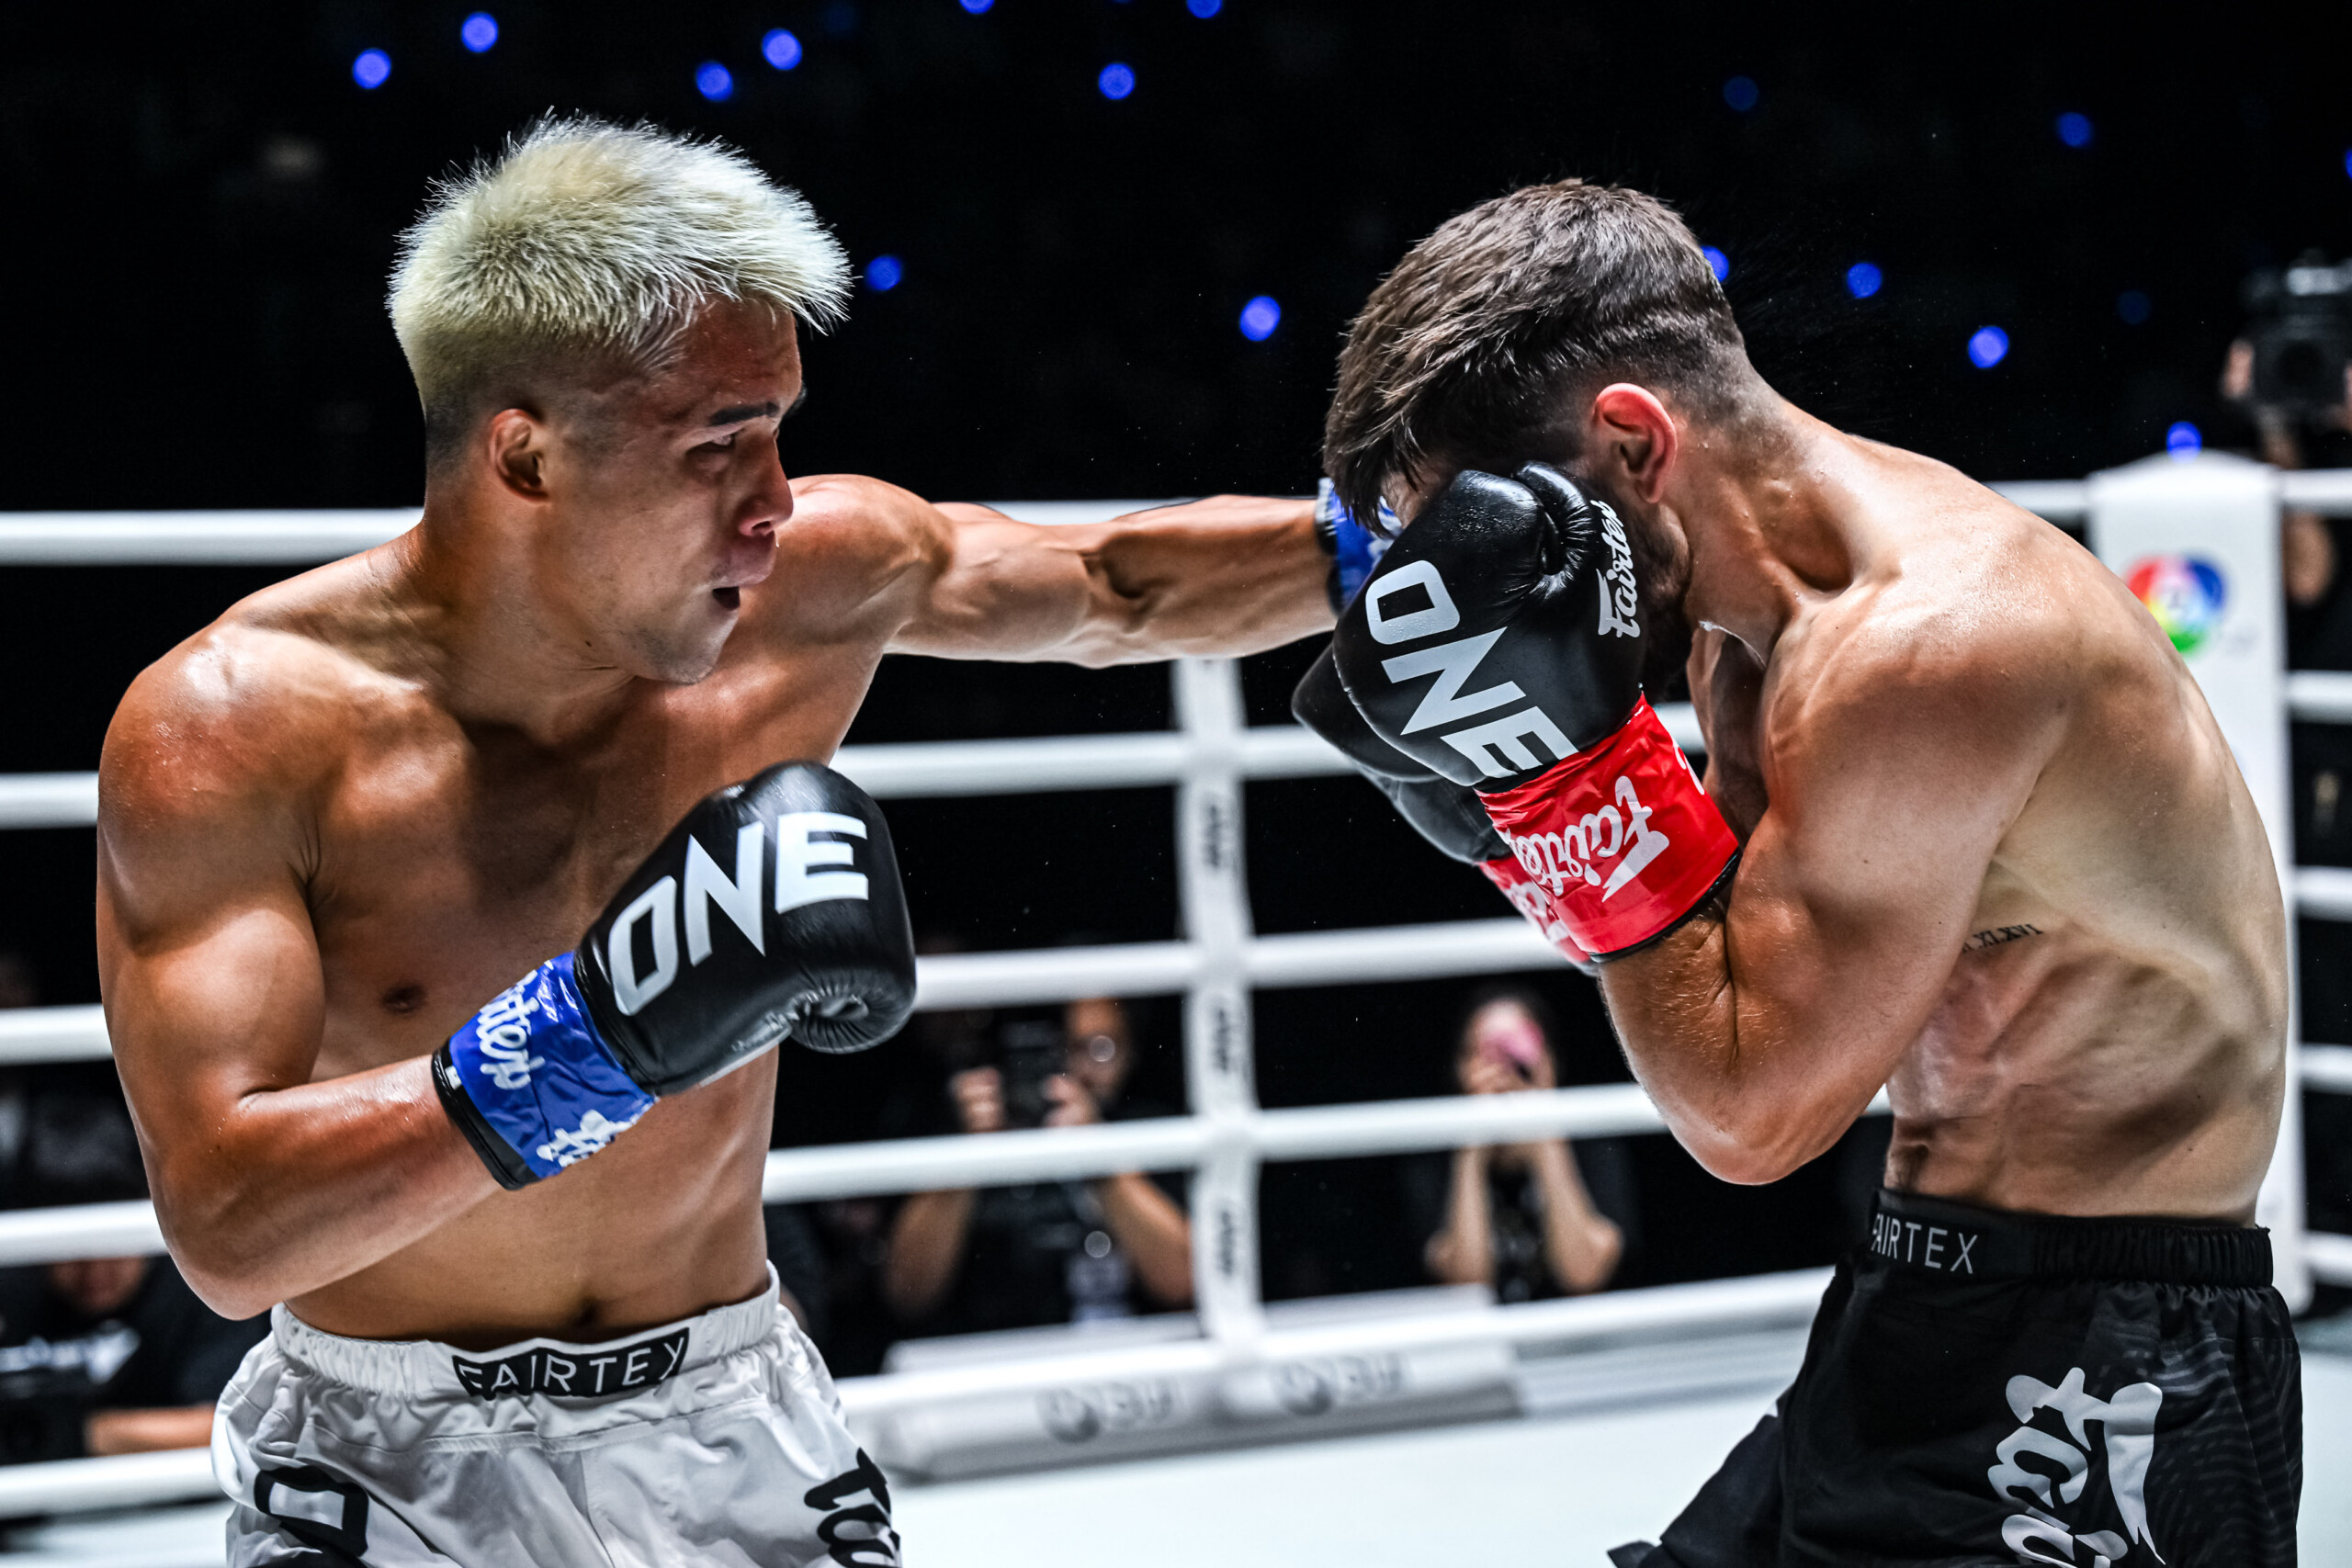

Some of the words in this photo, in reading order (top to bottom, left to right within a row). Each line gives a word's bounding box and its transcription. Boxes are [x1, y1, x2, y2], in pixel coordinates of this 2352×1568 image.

[1364, 559, 1580, 779] ONE
[1589, 499, 1641, 638] Fairtex
[607, 811, 869, 1017] ONE
